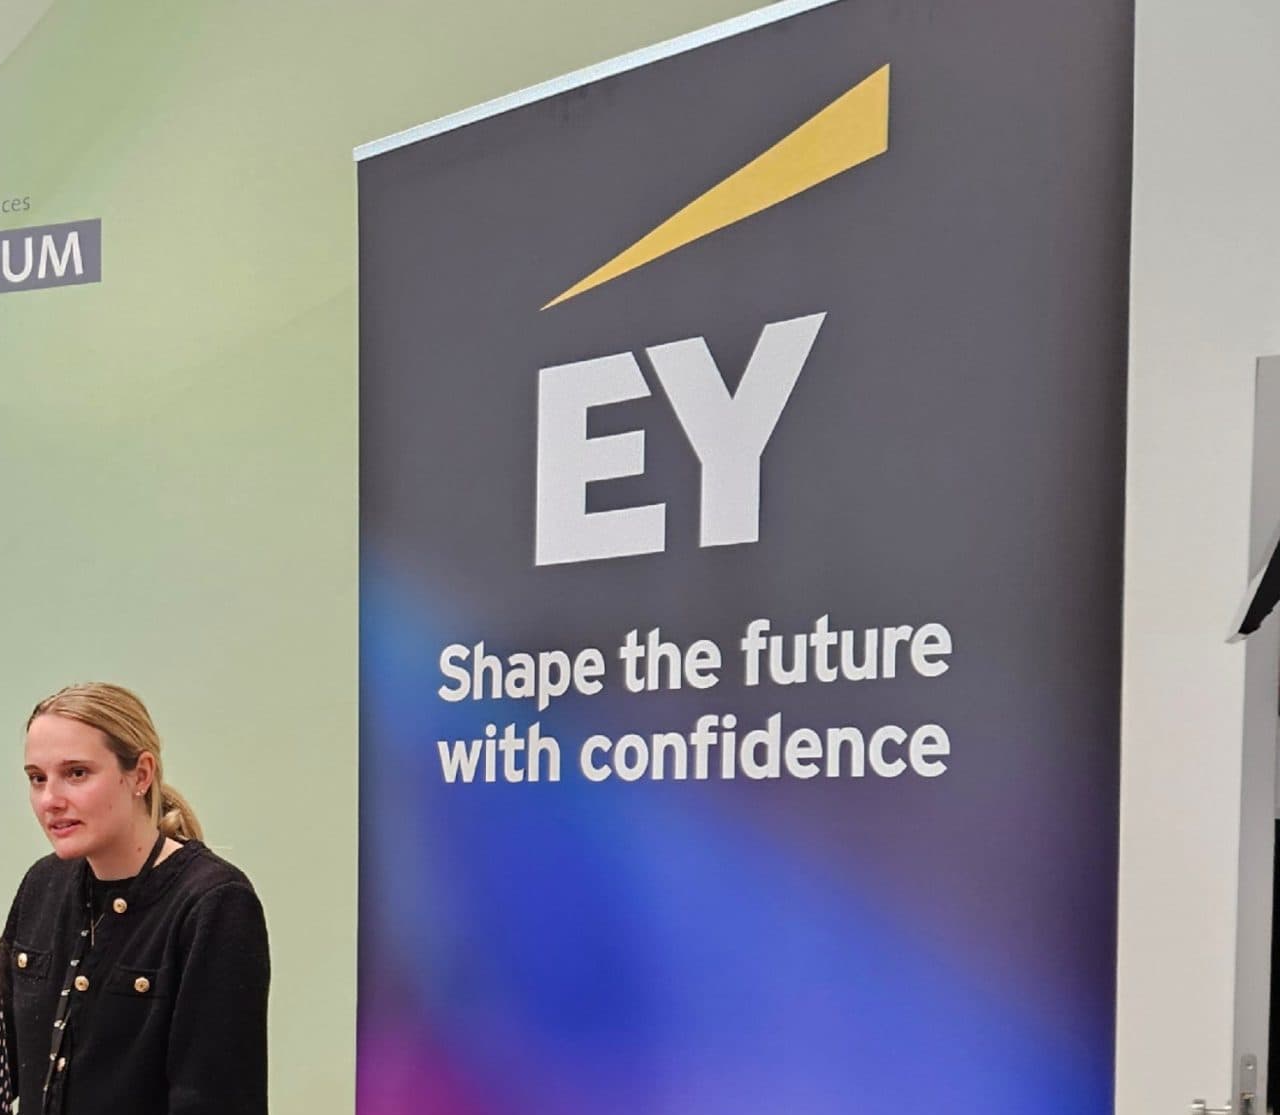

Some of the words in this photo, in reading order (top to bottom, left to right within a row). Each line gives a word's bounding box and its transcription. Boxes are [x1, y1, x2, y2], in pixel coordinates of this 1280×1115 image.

[534, 311, 827, 567] EY
[437, 641, 606, 712] Shape
[619, 627, 722, 693] the
[740, 614, 953, 687] future
[437, 722, 562, 783] with
[580, 711, 952, 780] confidence
